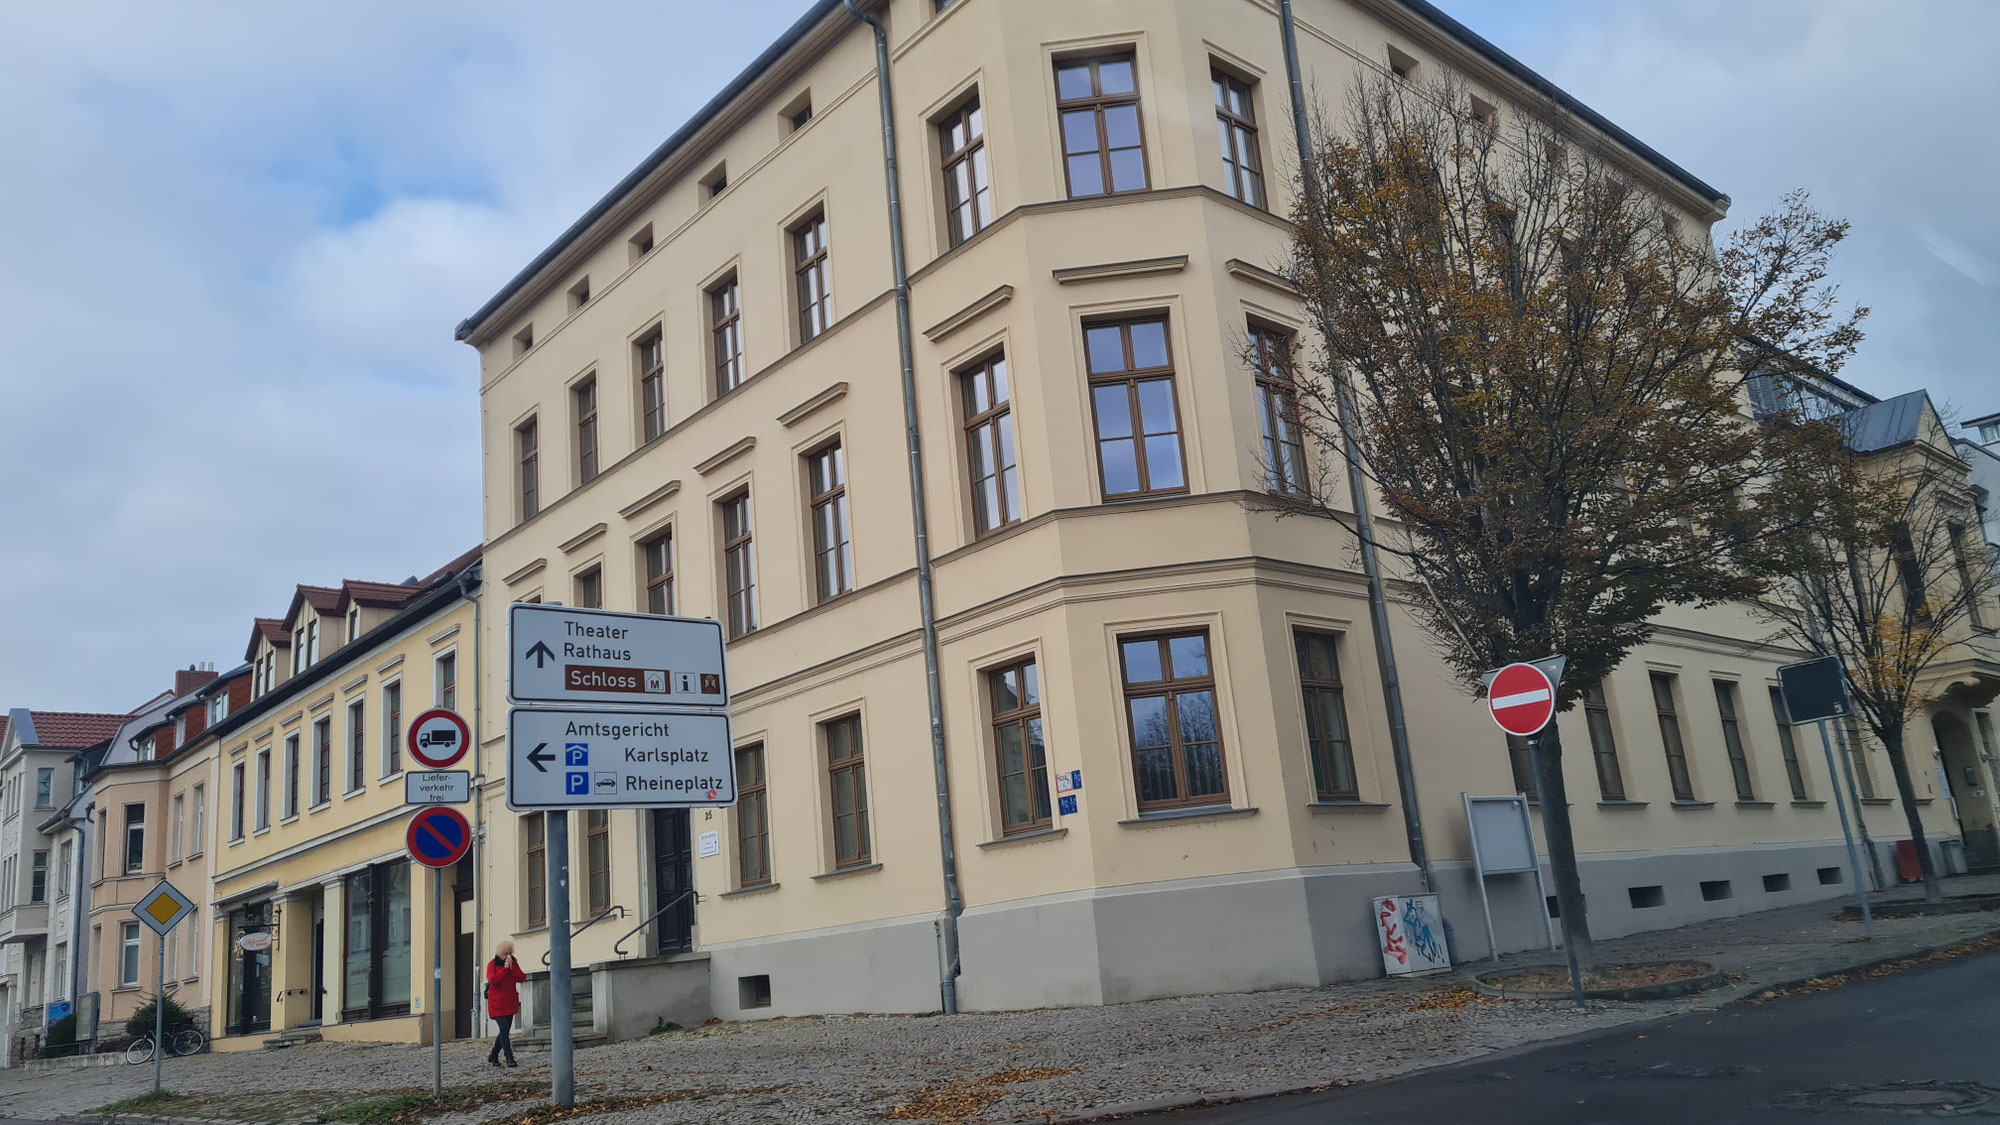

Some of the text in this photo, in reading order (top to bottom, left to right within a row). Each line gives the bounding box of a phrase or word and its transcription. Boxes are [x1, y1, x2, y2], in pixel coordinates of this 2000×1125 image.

[564, 621, 628, 639] Theater
[564, 642, 631, 661] Rathaus
[570, 670, 636, 688] Schloss
[565, 721, 670, 740] Amtsgericht
[625, 747, 709, 766] Karlsplatz
[571, 775, 723, 794] P Rheineplatz
[430, 794, 444, 802] frei
